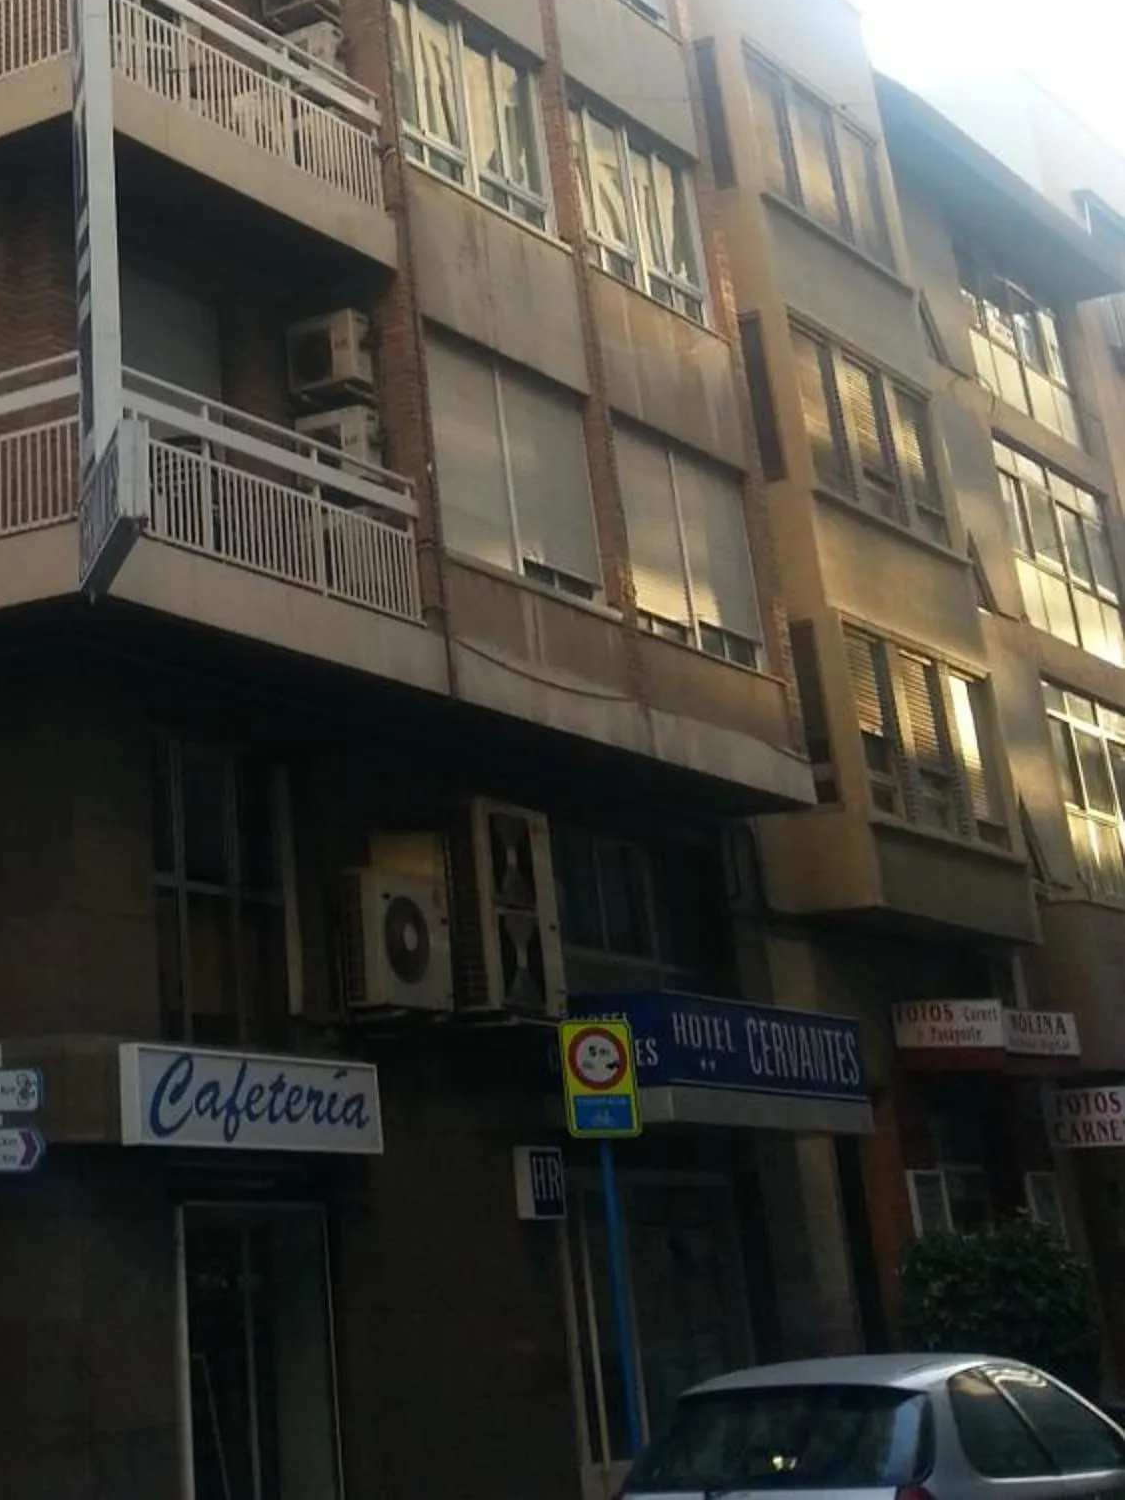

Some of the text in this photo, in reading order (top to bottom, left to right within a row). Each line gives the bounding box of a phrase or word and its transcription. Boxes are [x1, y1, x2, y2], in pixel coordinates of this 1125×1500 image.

[672, 1011, 737, 1053] HOTEL
[745, 1017, 860, 1085] CERVANTES
[149, 1052, 370, 1142] Cafetería
[1056, 1091, 1121, 1117] FOTOS
[1054, 1120, 1125, 1143] CARNE
